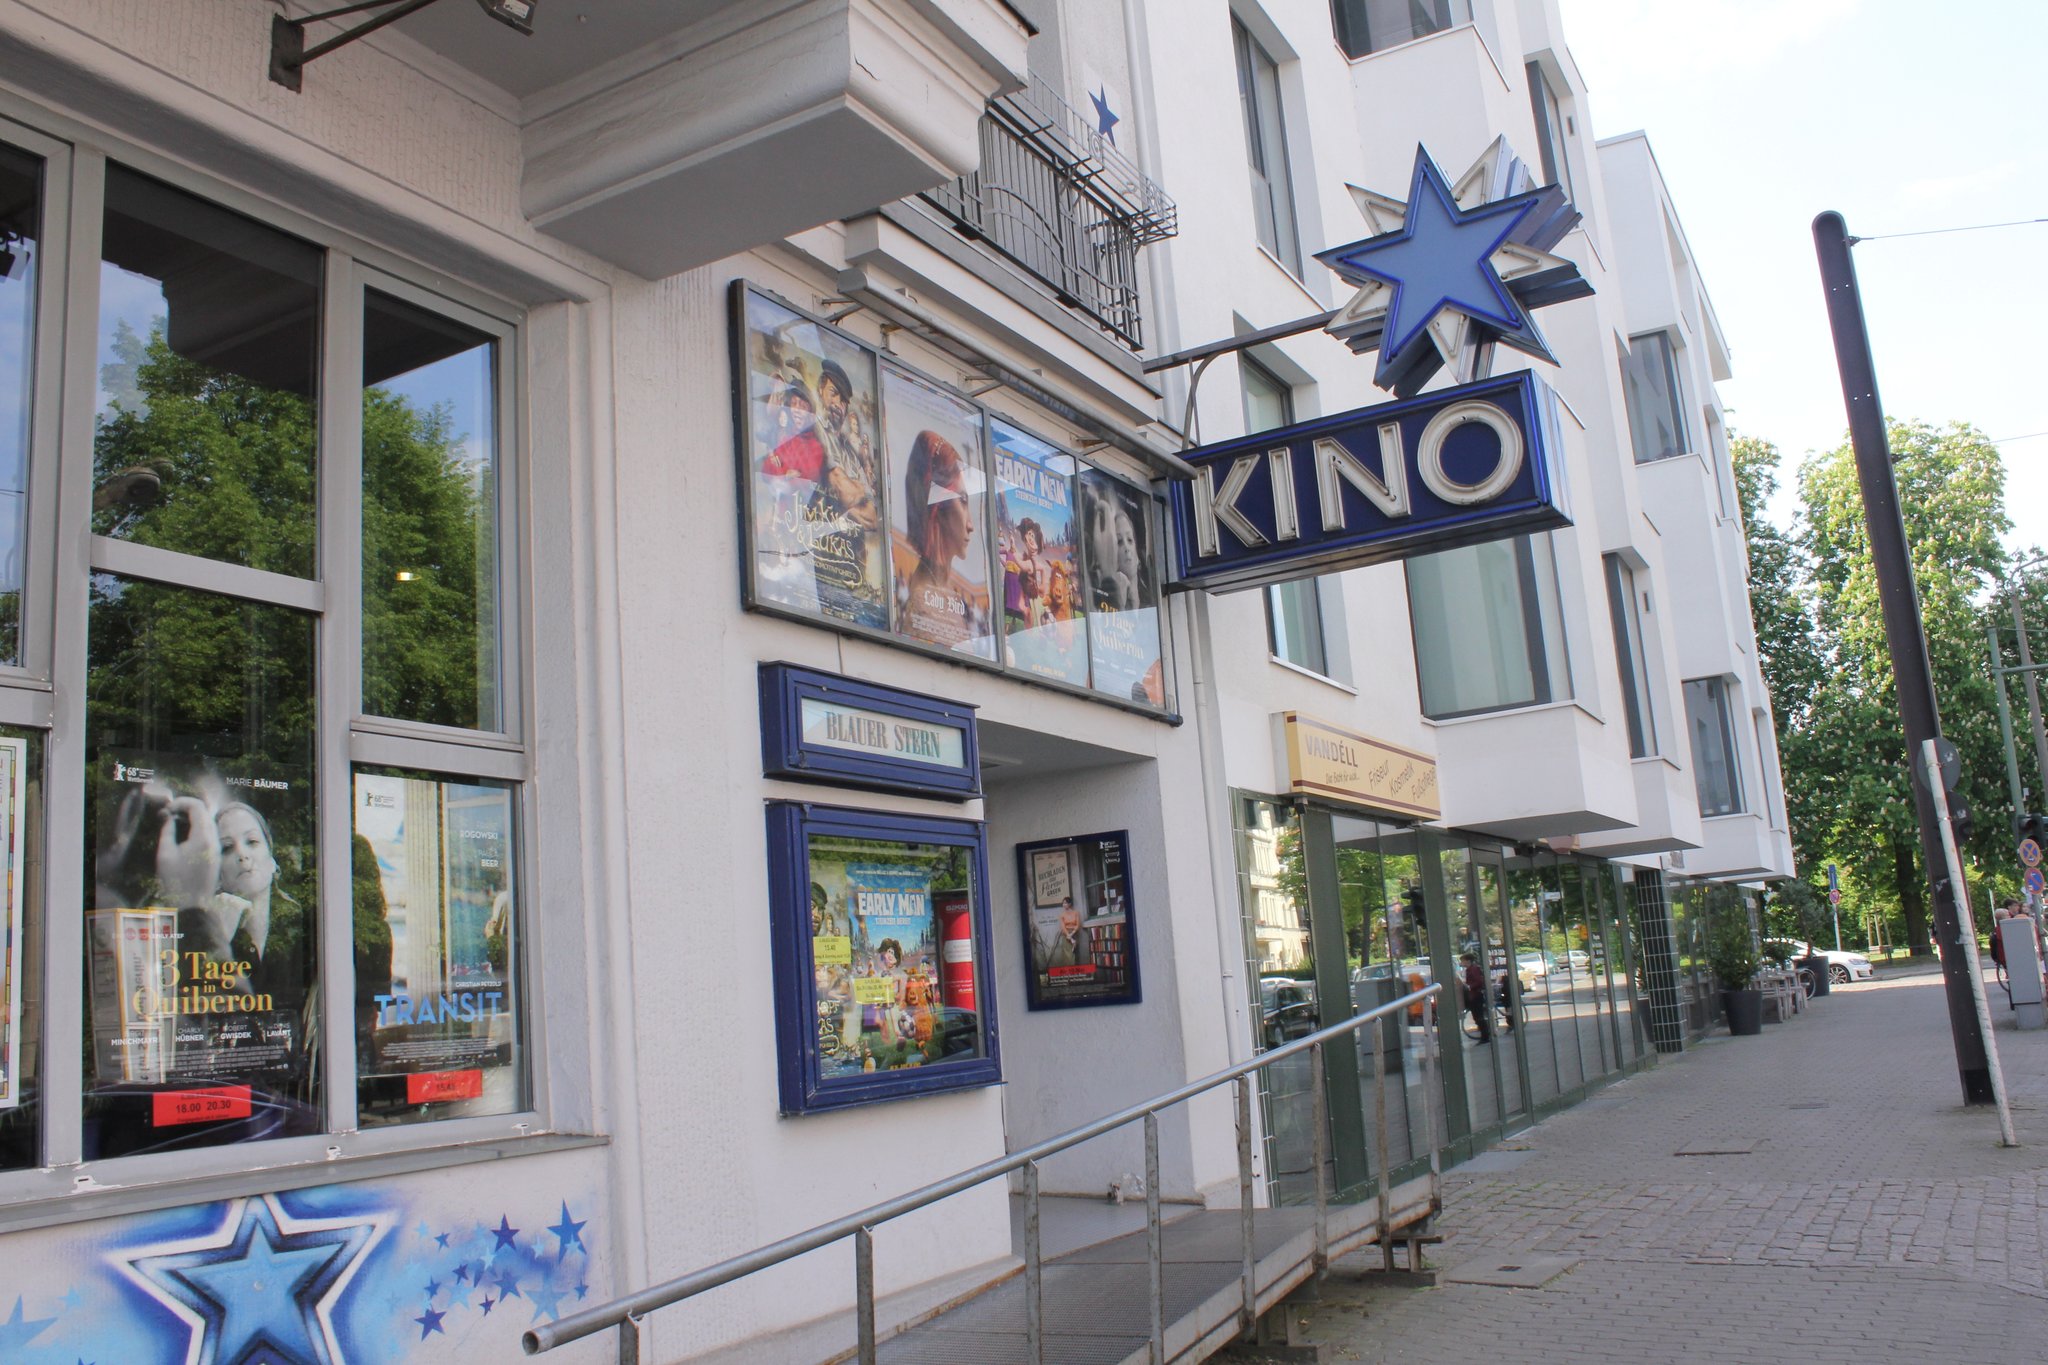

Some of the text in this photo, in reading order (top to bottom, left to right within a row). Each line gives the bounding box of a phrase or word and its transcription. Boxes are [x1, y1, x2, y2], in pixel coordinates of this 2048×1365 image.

[994, 454, 1036, 494] EARLY
[1192, 400, 1525, 558] KINO
[924, 590, 966, 616] Lady Bird
[825, 711, 941, 759] BLAUER STERN
[1305, 734, 1359, 768] VANDÉLL
[226, 777, 289, 791] MARIE BÄUMER
[480, 859, 499, 868] BEER
[857, 892, 926, 917] EARLY MAN
[159, 949, 252, 990] 3 Tage
[203, 980, 216, 993] in
[132, 986, 274, 1023] Quiberon
[373, 991, 503, 1026] TRANSIT
[175, 1032, 205, 1042] HÜBNER
[175, 1099, 232, 1114] 18.00 20.30
